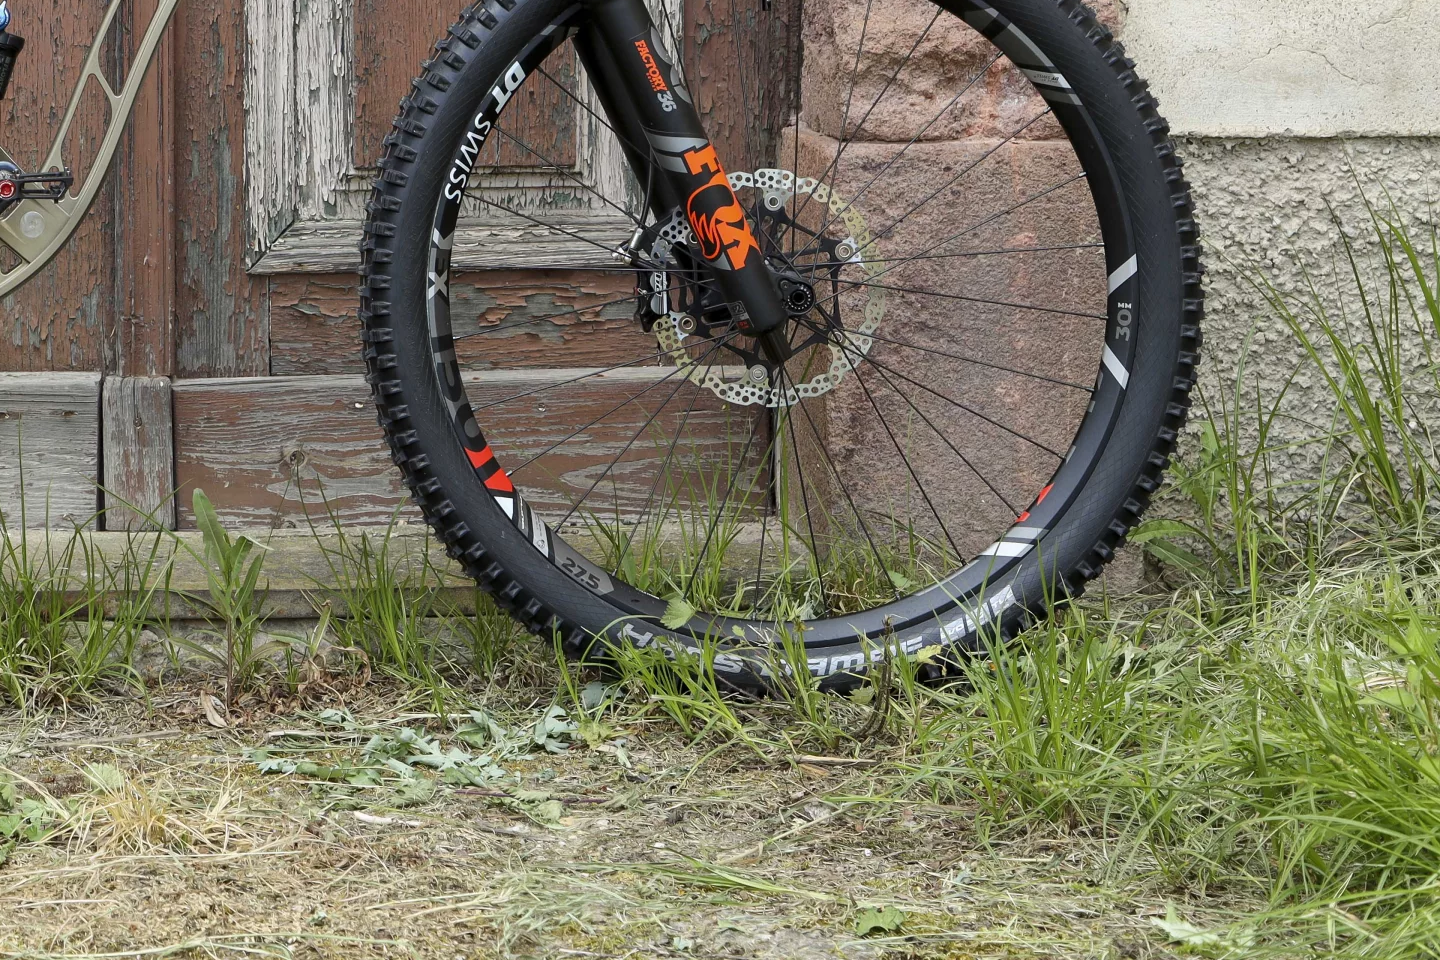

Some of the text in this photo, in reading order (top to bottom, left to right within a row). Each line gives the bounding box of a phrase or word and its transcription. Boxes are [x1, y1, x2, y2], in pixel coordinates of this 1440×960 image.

[634, 39, 677, 112] FACTORY 36
[444, 61, 526, 204] DT SWISS
[684, 144, 762, 271] FOX
[561, 556, 601, 590] 27.5
